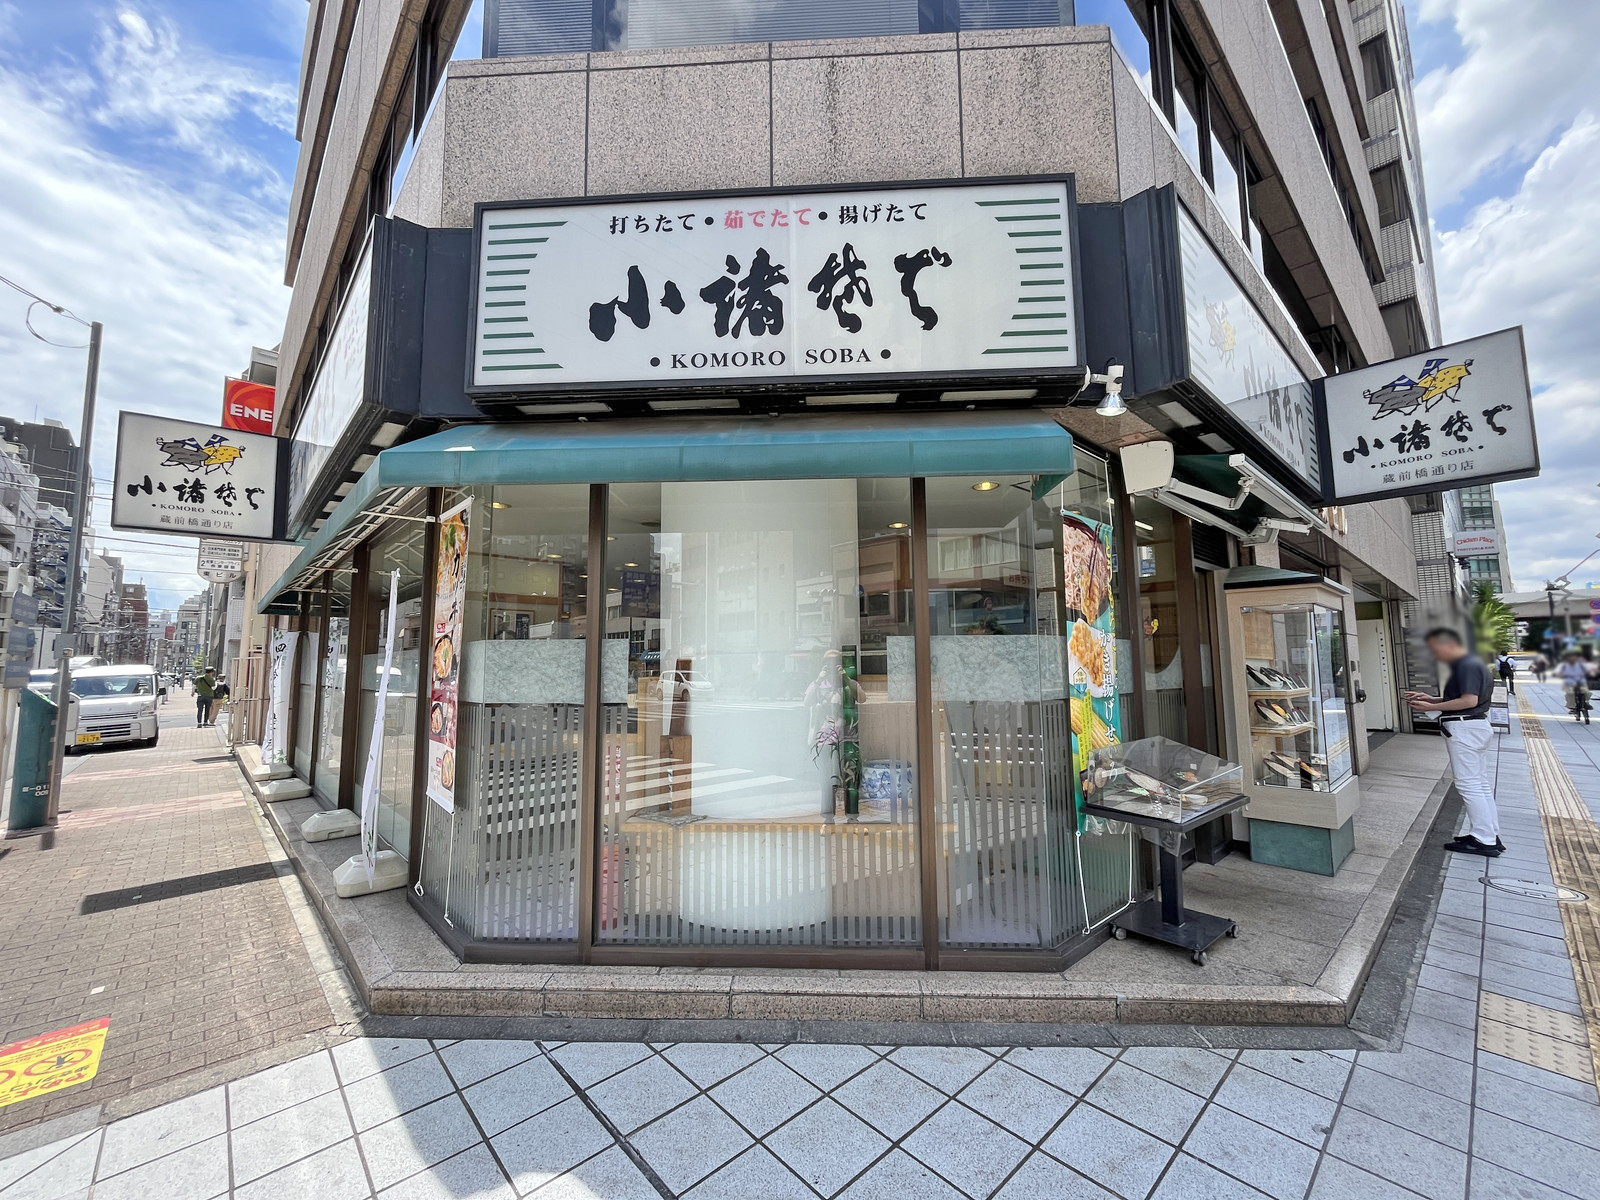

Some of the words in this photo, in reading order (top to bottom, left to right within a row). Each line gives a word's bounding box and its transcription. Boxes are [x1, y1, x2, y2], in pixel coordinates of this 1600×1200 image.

[671, 350, 786, 369] KOMORO
[805, 347, 871, 366] SOBA
[1380, 453, 1433, 468] KOMORO
[1441, 446, 1474, 458] SOBA
[1383, 459, 1474, 484] 蔵前橋通り店
[160, 503, 205, 513] KOMORO
[211, 508, 235, 516] SOBA
[160, 514, 233, 529] 蔵前橋通り店
